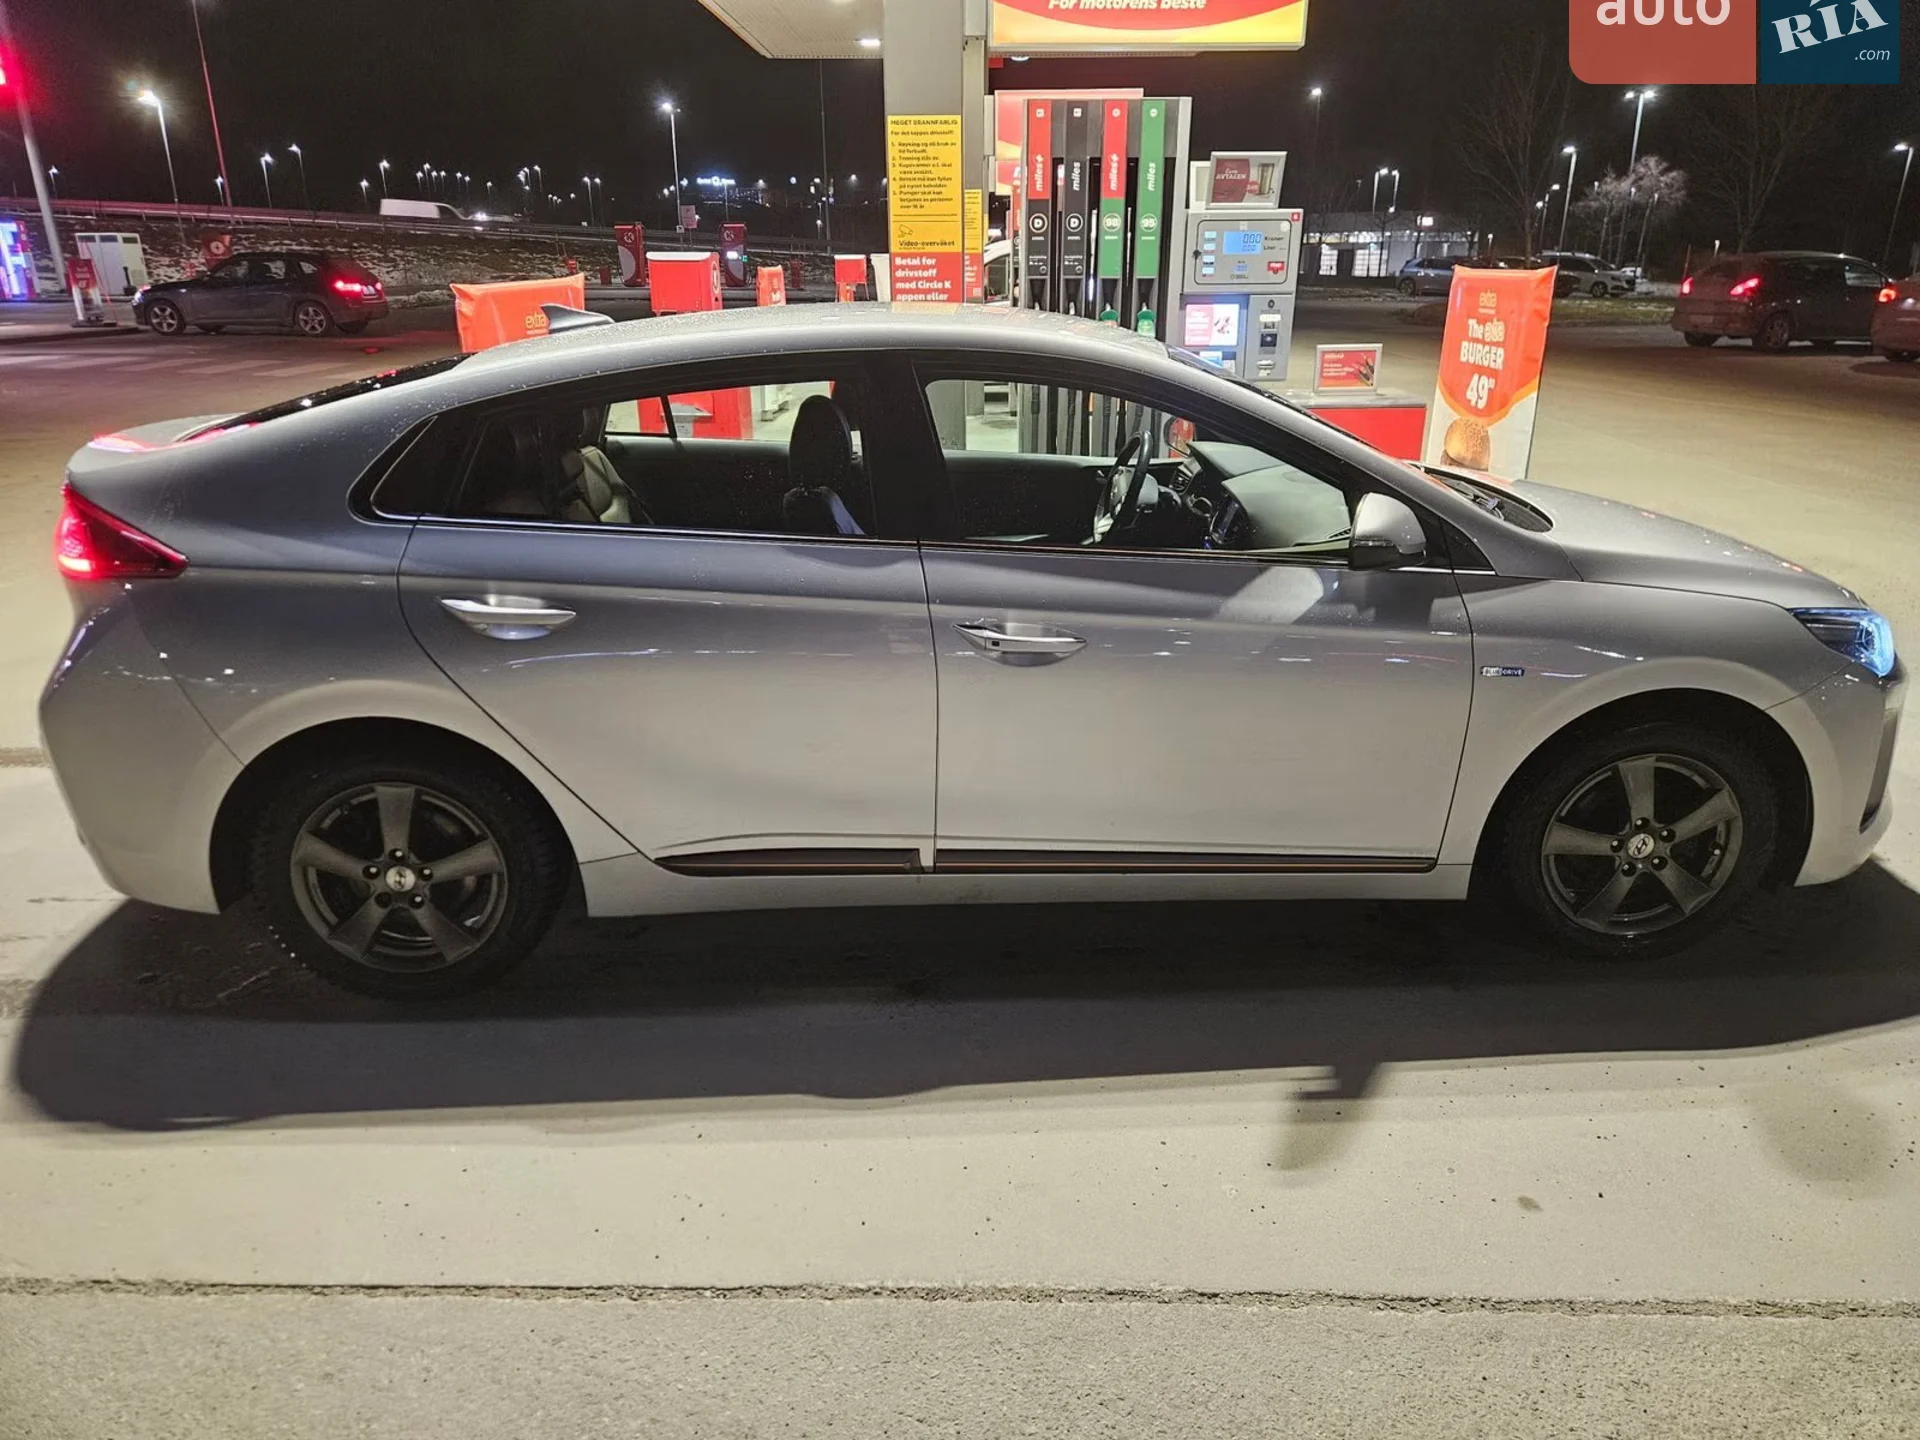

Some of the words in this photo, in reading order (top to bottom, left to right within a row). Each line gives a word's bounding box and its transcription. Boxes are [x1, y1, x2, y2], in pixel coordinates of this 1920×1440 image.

[1072, 161, 1081, 191] miles
[1147, 162, 1156, 191] miles
[1034, 218, 1043, 228] D
[1070, 218, 1079, 228] D
[1142, 218, 1155, 227] 95
[895, 257, 920, 265] Betal
[922, 257, 936, 265] for
[895, 268, 936, 277] drivstoff
[896, 280, 916, 288] med
[918, 280, 944, 288] Circle
[945, 280, 952, 288] K
[926, 292, 948, 300] eller
[1468, 318, 1483, 338] The
[1460, 342, 1505, 370] BURGER
